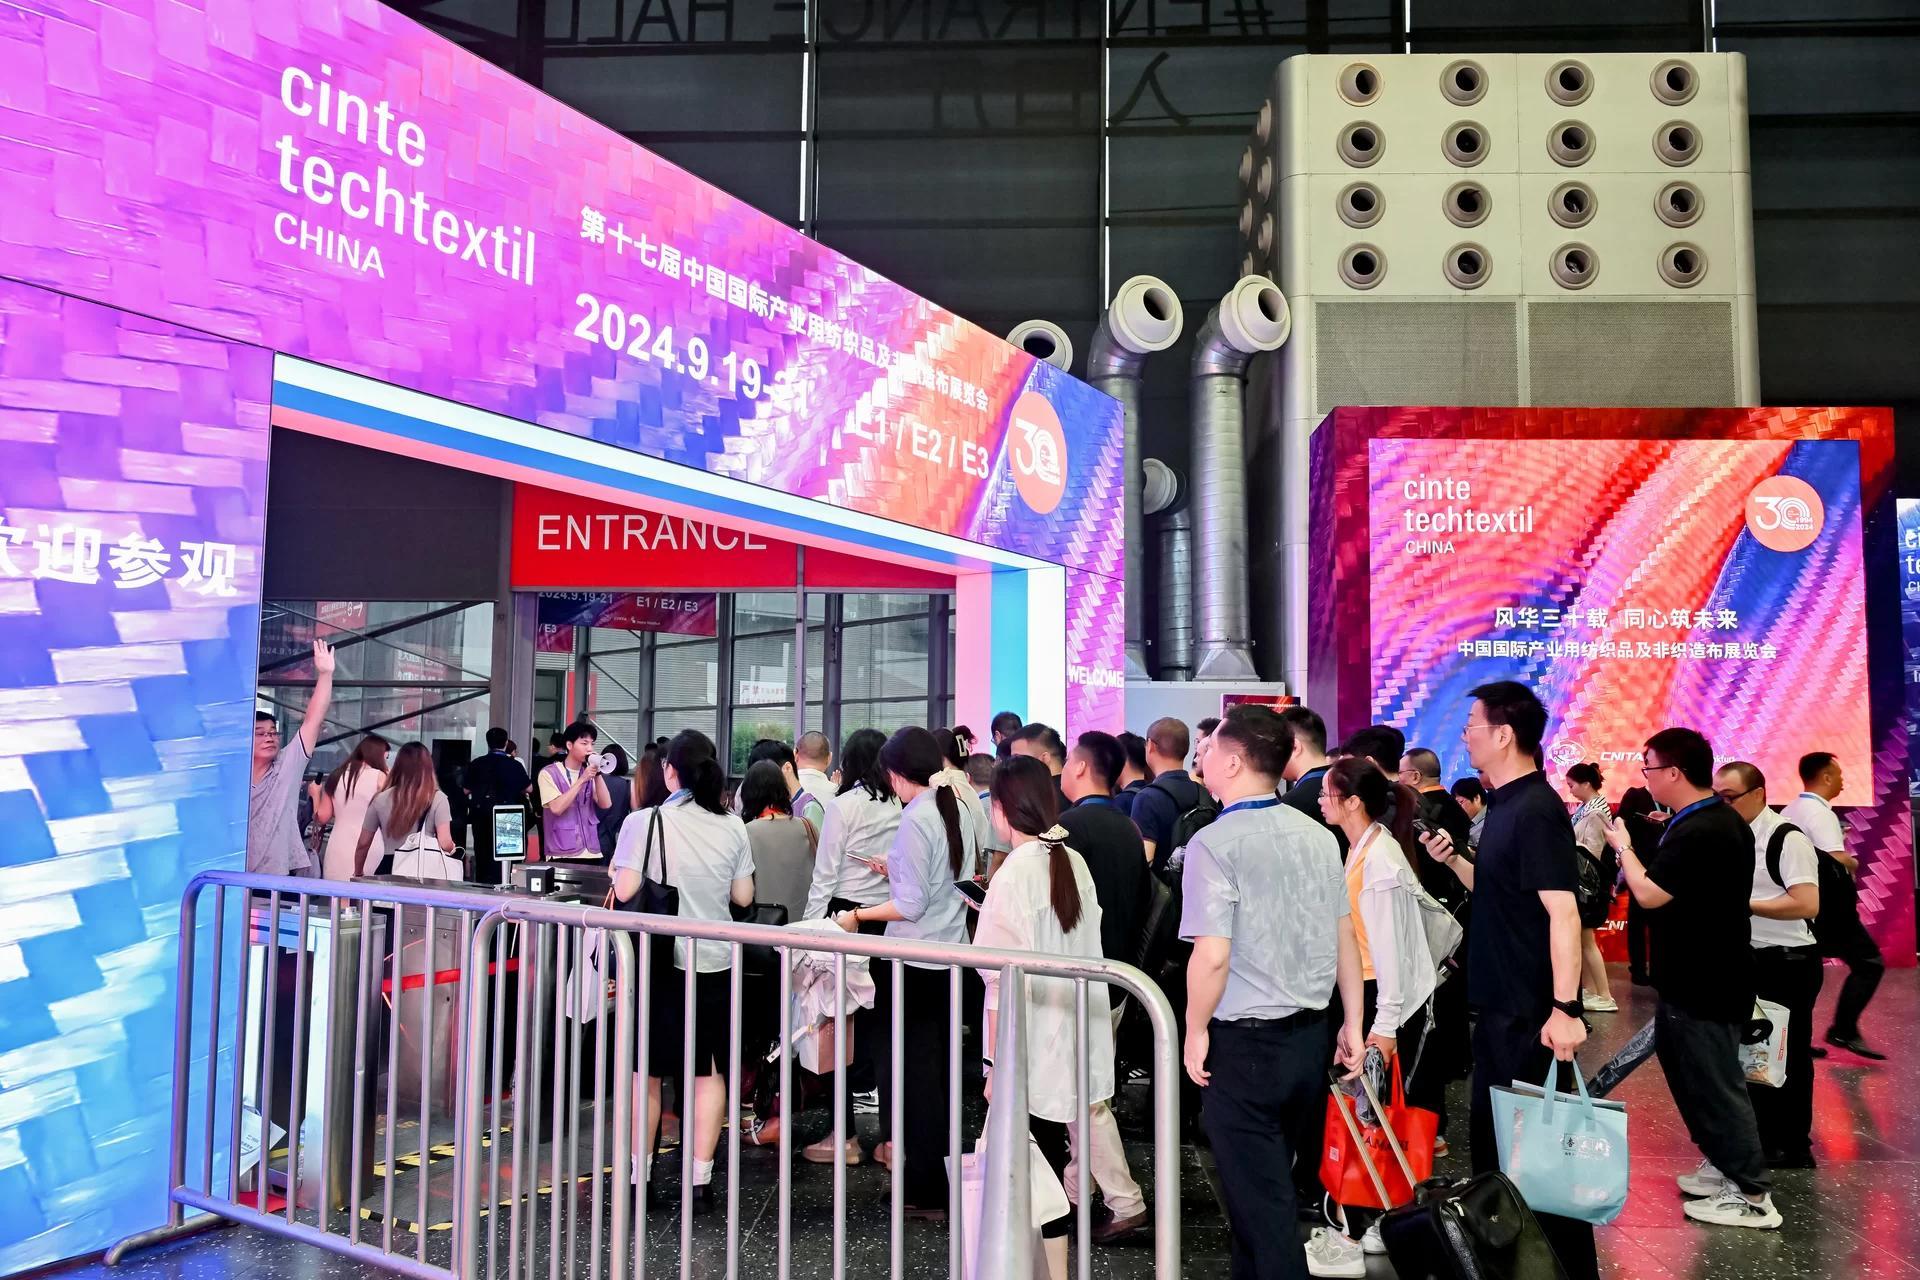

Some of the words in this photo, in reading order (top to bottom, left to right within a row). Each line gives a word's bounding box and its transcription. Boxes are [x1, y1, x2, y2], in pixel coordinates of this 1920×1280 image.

[281, 63, 426, 168] cinte
[275, 134, 535, 286] techtextil
[274, 212, 385, 279] CHINA
[912, 422, 942, 464] E2
[962, 440, 989, 480] E3
[1404, 473, 1471, 500] cinte
[1404, 506, 1533, 533] techtextil
[1405, 540, 1456, 554] CHINA
[637, 596, 650, 608] E1
[661, 599, 675, 610] E2
[685, 601, 698, 612] E3
[1494, 607, 1609, 629] 风华三十载
[1624, 608, 1738, 630] 同心筑未来
[1457, 640, 1777, 660] 中国国际产业用纺织品及非织造布展览会
[1068, 664, 1124, 688] WELCOME
